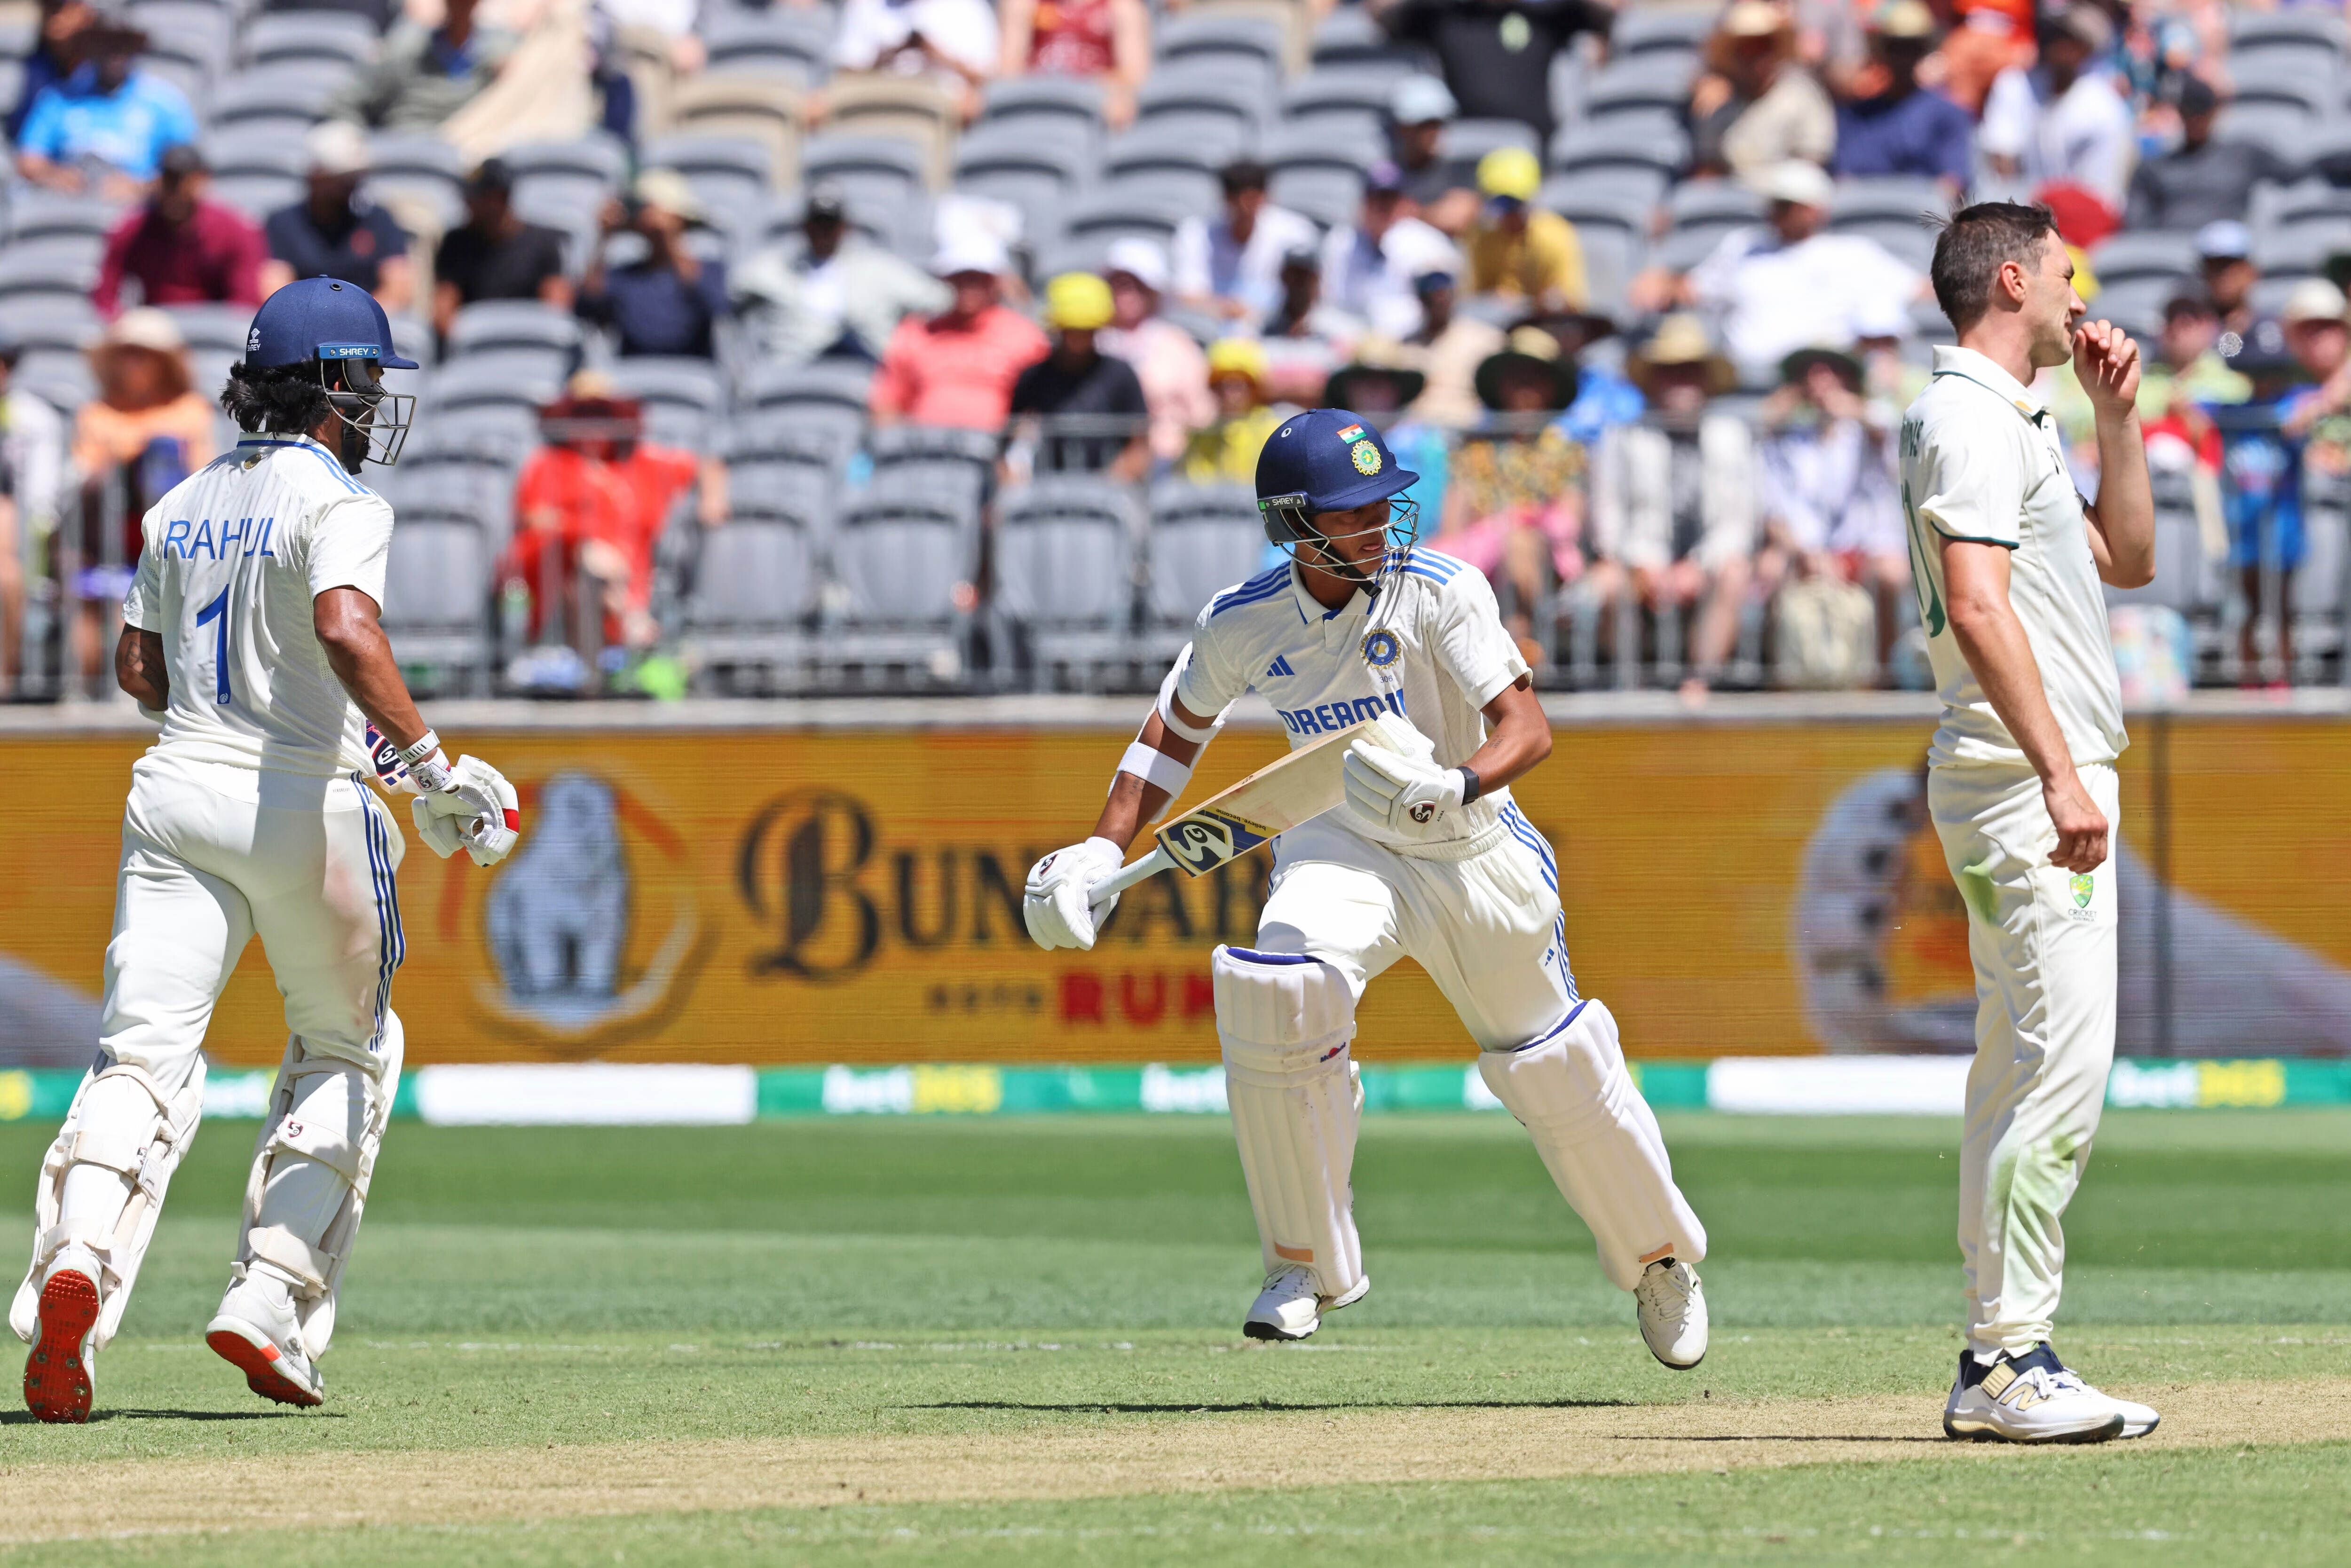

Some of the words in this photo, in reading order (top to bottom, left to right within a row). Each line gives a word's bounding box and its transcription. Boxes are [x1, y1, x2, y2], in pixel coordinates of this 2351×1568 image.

[247, 343, 260, 351] SHREY
[1272, 497, 1294, 506] SHREY
[164, 517, 274, 560] RAHUL
[197, 583, 231, 704] 1
[1379, 675, 1393, 684] 306
[1215, 808, 1241, 822] become
[1436, 810, 1445, 822] TEST
[1242, 818, 1266, 831] believe.
[1170, 824, 1229, 862] SG
[2068, 908, 2098, 917] CRICKET
